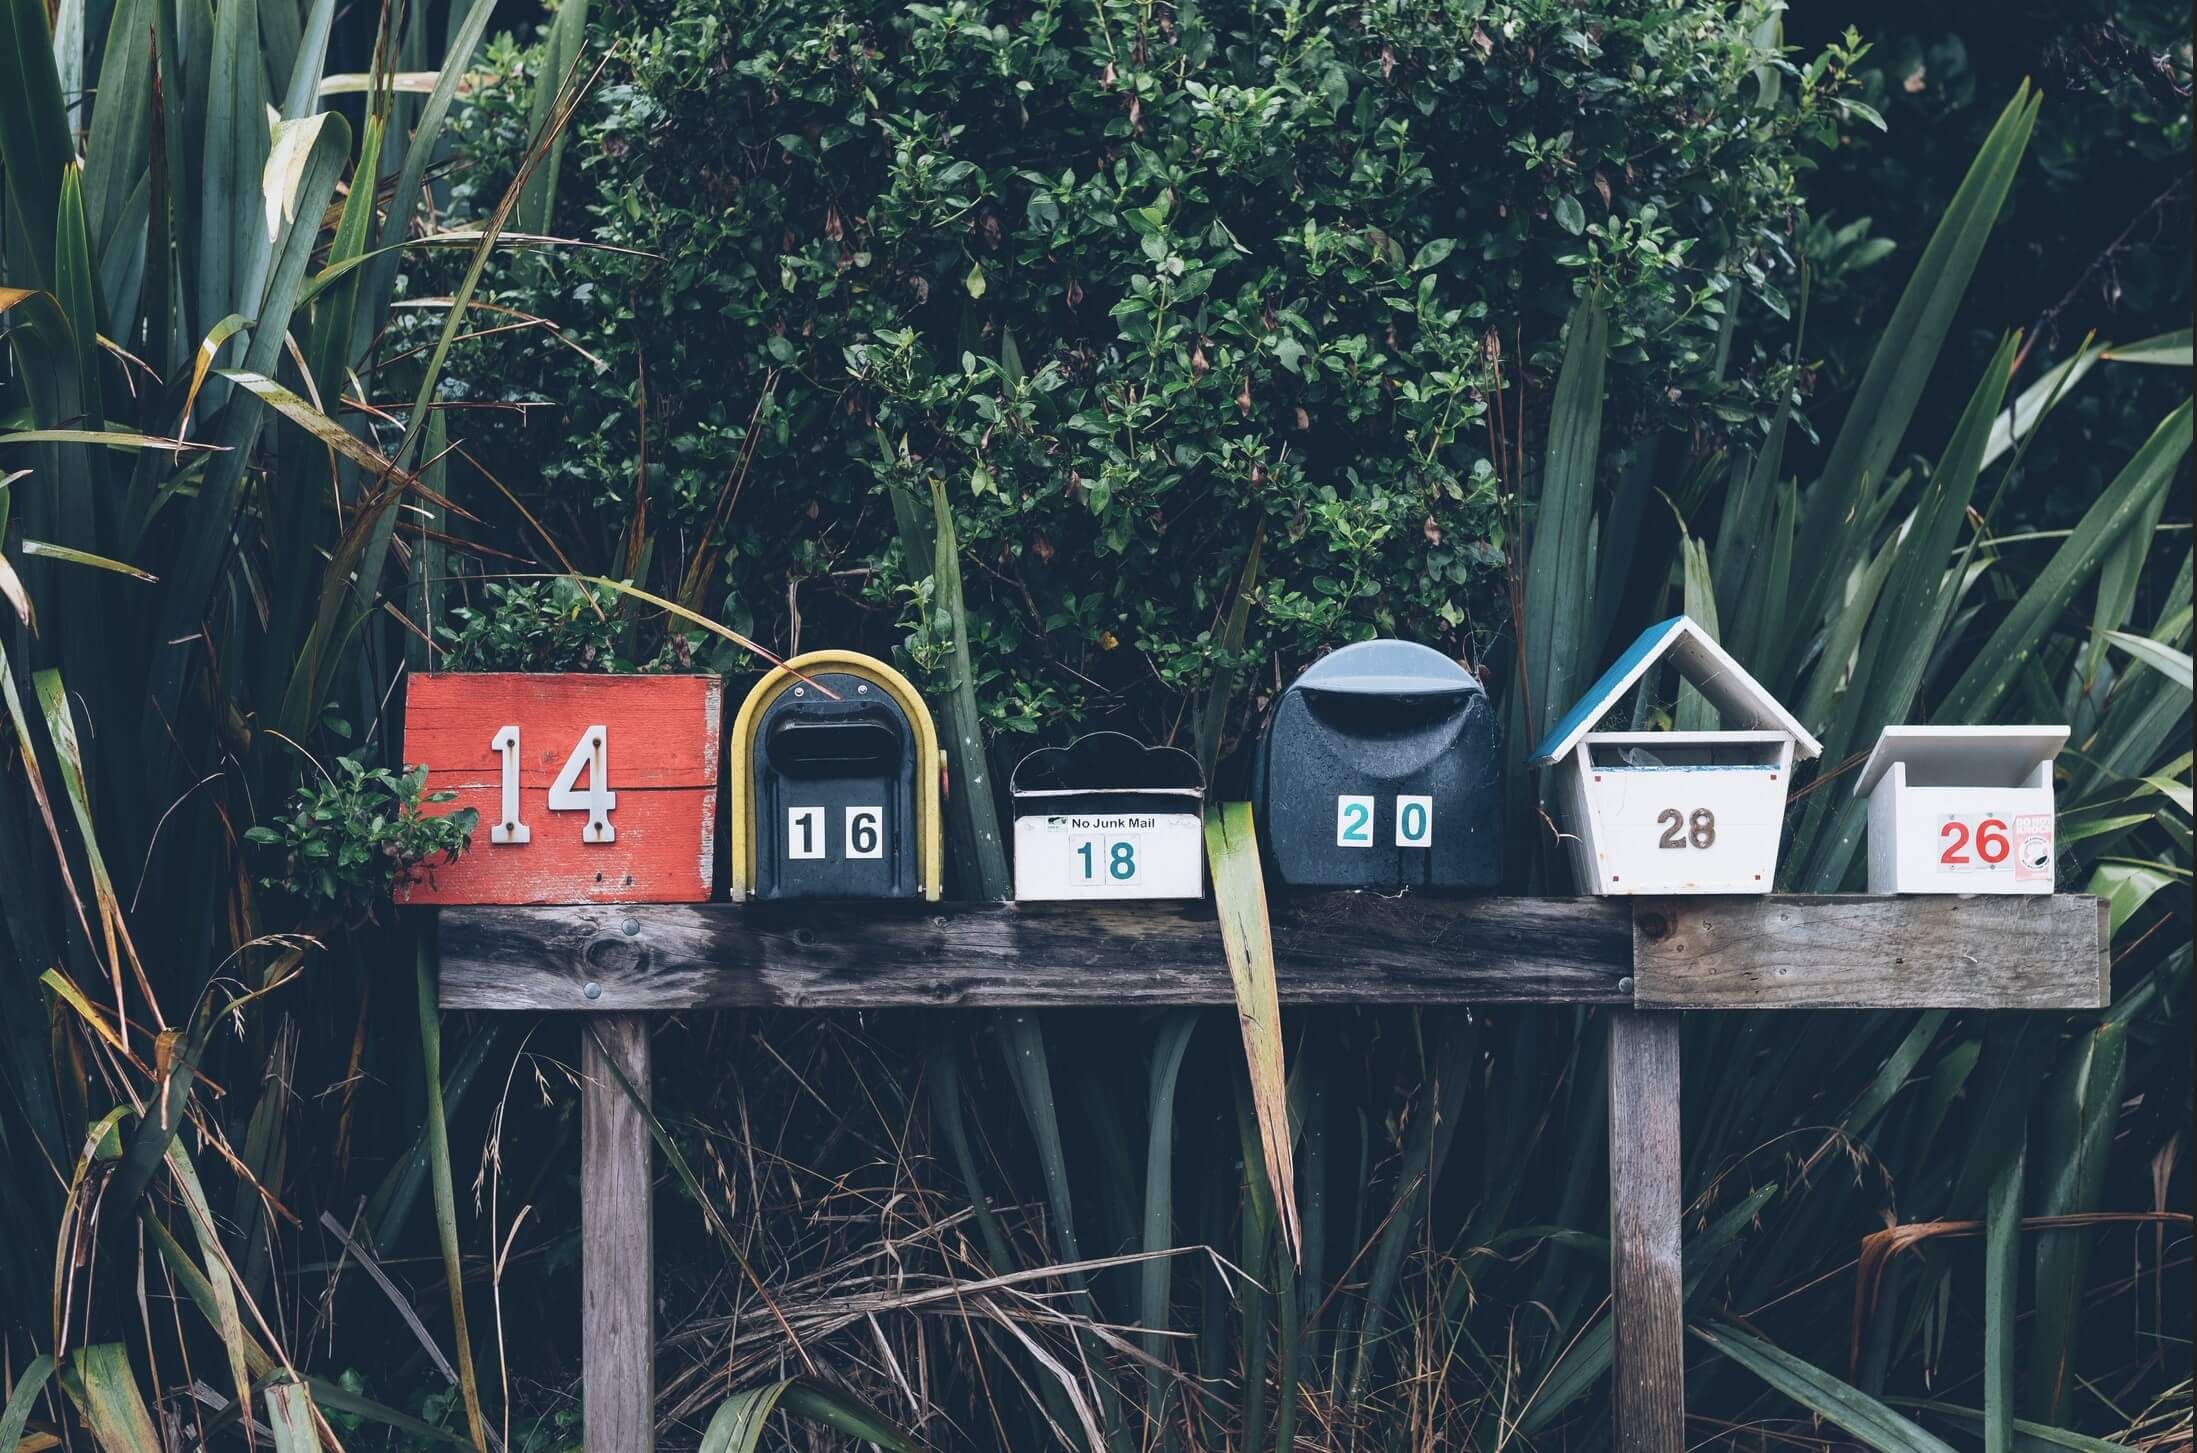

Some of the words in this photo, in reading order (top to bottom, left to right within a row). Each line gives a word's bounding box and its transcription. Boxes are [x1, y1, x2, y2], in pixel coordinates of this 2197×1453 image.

[491, 725, 616, 844] 14
[1072, 818, 1090, 829] No
[1093, 818, 1125, 829] Junk
[1128, 818, 1155, 829] Mail
[1657, 807, 1716, 850] 28
[1940, 819, 2010, 864] 26
[1077, 842, 1136, 880] 18
